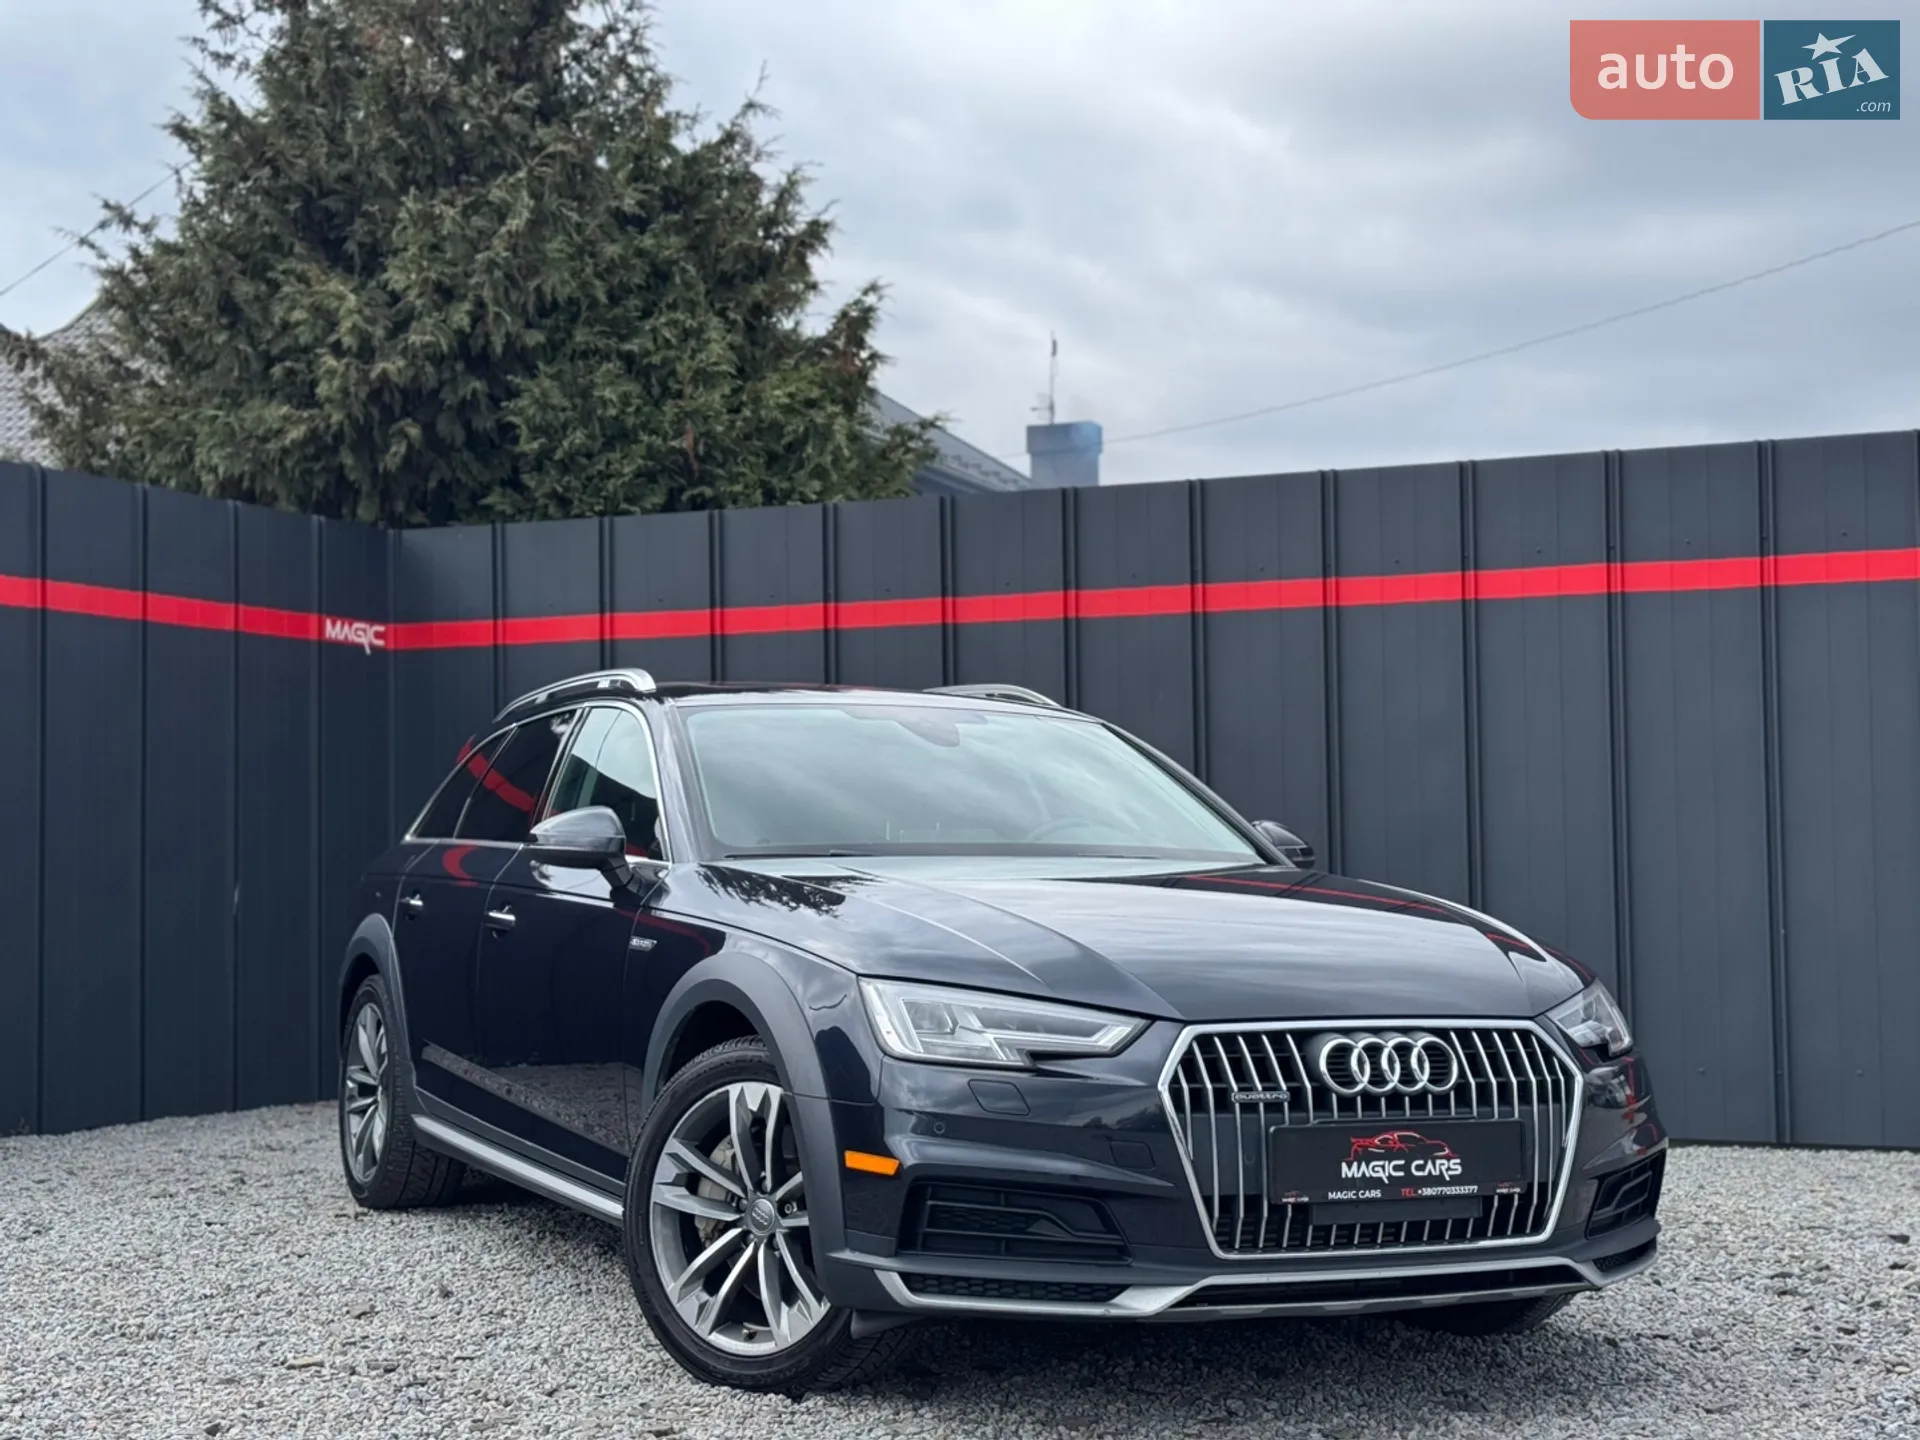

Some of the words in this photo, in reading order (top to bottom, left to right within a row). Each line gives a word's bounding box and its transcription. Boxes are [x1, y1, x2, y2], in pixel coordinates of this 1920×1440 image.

[325, 617, 386, 656] MAGIC
[1341, 1160, 1405, 1184] MAGIC
[1411, 1159, 1462, 1181] CARS
[1327, 1190, 1357, 1200] MAGIC
[1358, 1189, 1382, 1199] CARS
